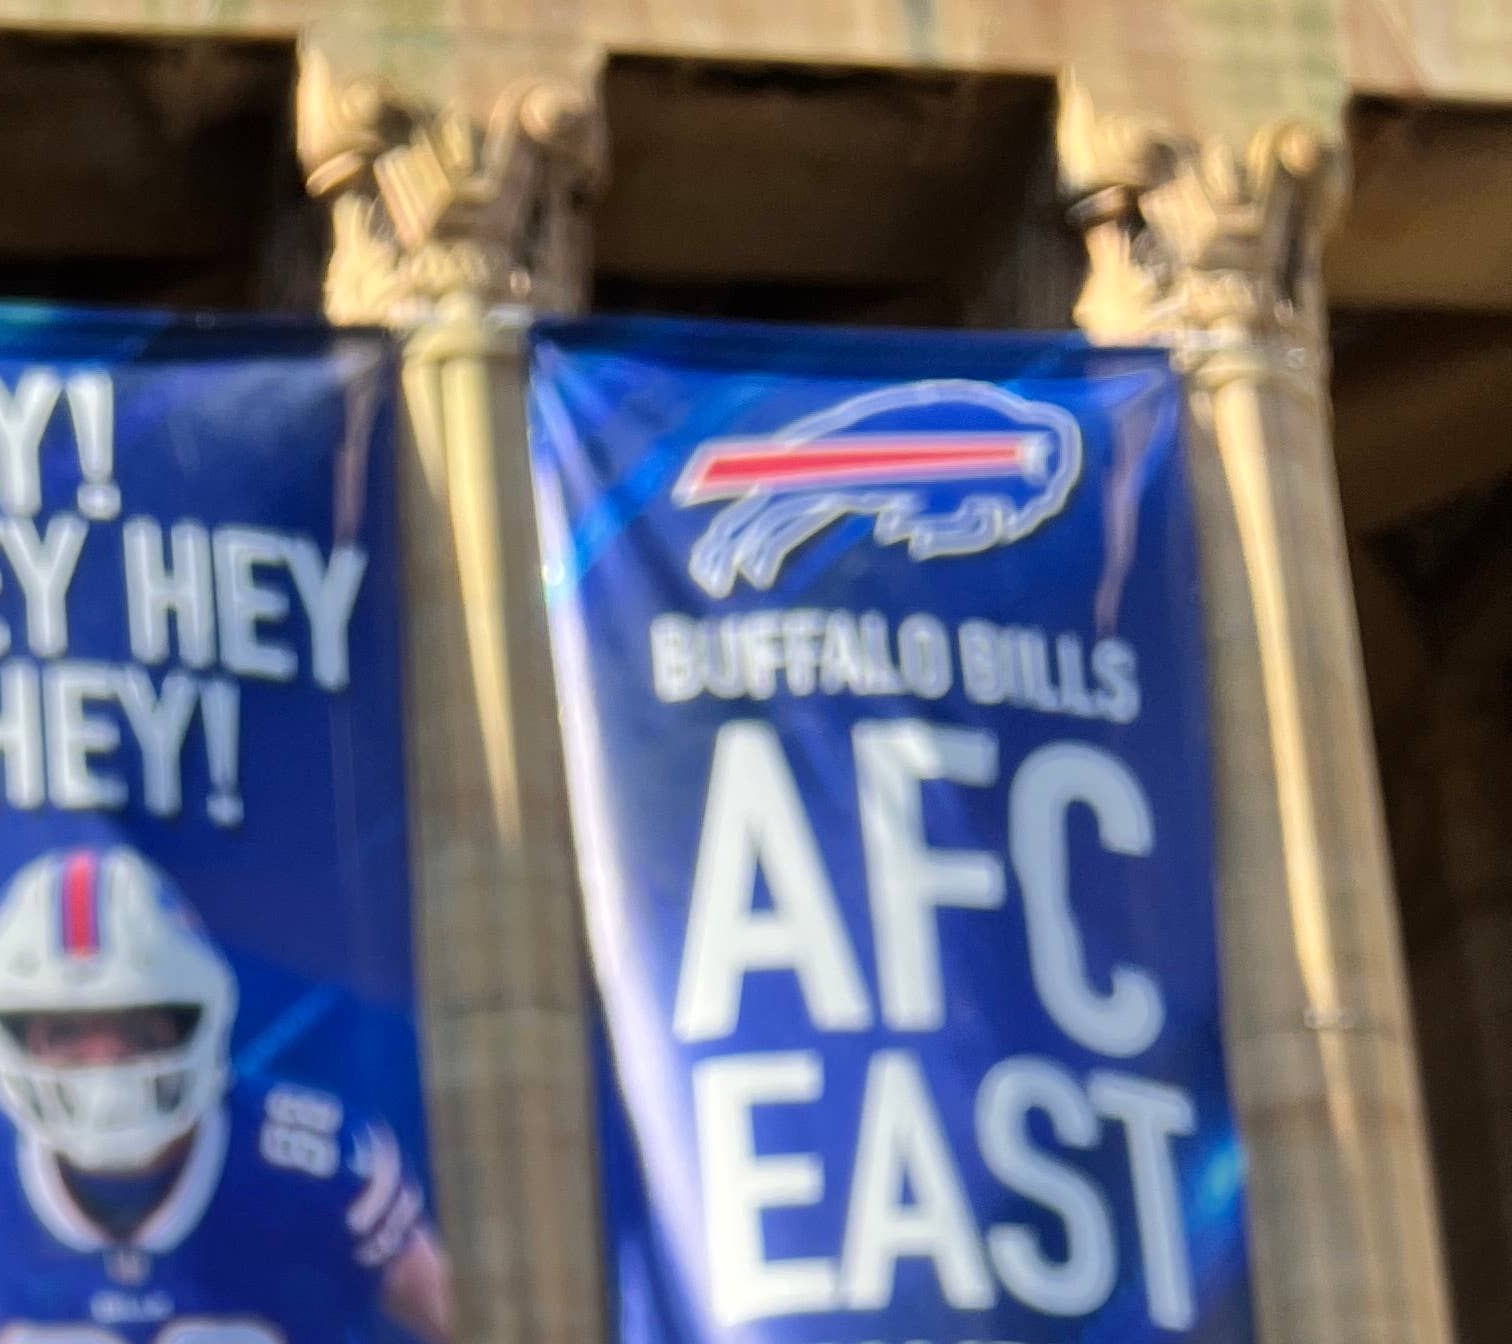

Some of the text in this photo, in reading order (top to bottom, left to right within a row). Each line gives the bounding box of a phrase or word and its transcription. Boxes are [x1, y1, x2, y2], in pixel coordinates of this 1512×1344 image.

[123, 514, 367, 692] HEY
[649, 609, 1142, 725] BUFFALO BILLS
[672, 718, 1167, 1059] AFC
[692, 1047, 1199, 1333] EAST
